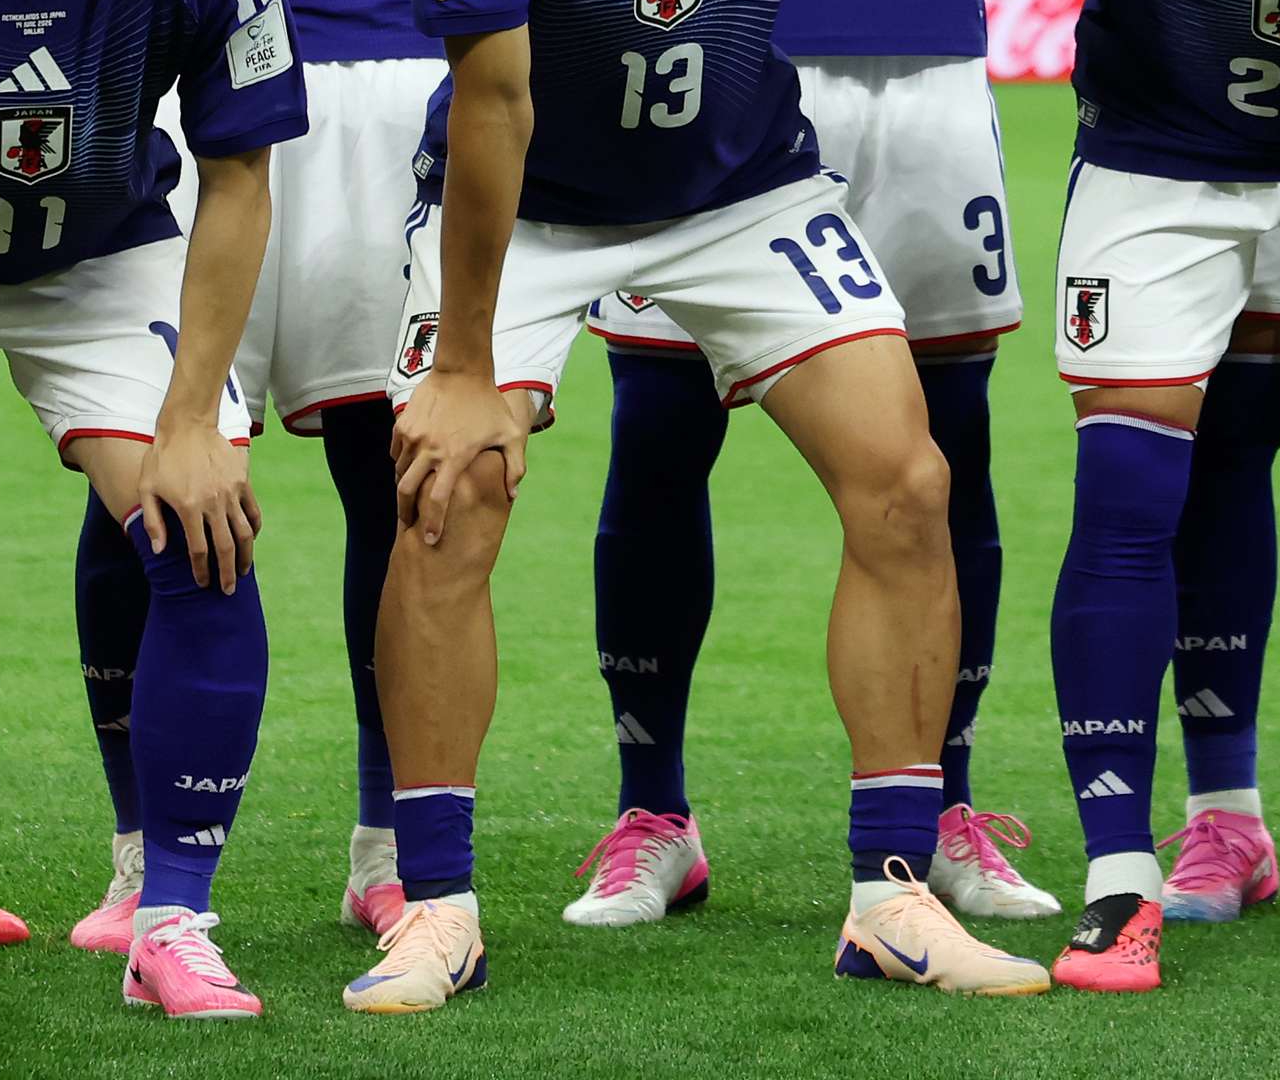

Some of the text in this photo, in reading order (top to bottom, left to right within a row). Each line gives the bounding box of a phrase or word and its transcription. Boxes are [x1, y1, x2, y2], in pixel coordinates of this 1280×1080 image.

[653, 0, 682, 16] JFA
[245, 46, 276, 68] PEACE
[254, 62, 272, 73] FIFA
[621, 43, 704, 128] 13
[14, 109, 53, 117] JAPAN
[963, 195, 1007, 296] 3
[769, 213, 882, 314] 13
[598, 651, 659, 674] PAN
[1062, 719, 1146, 737] JAPAN
